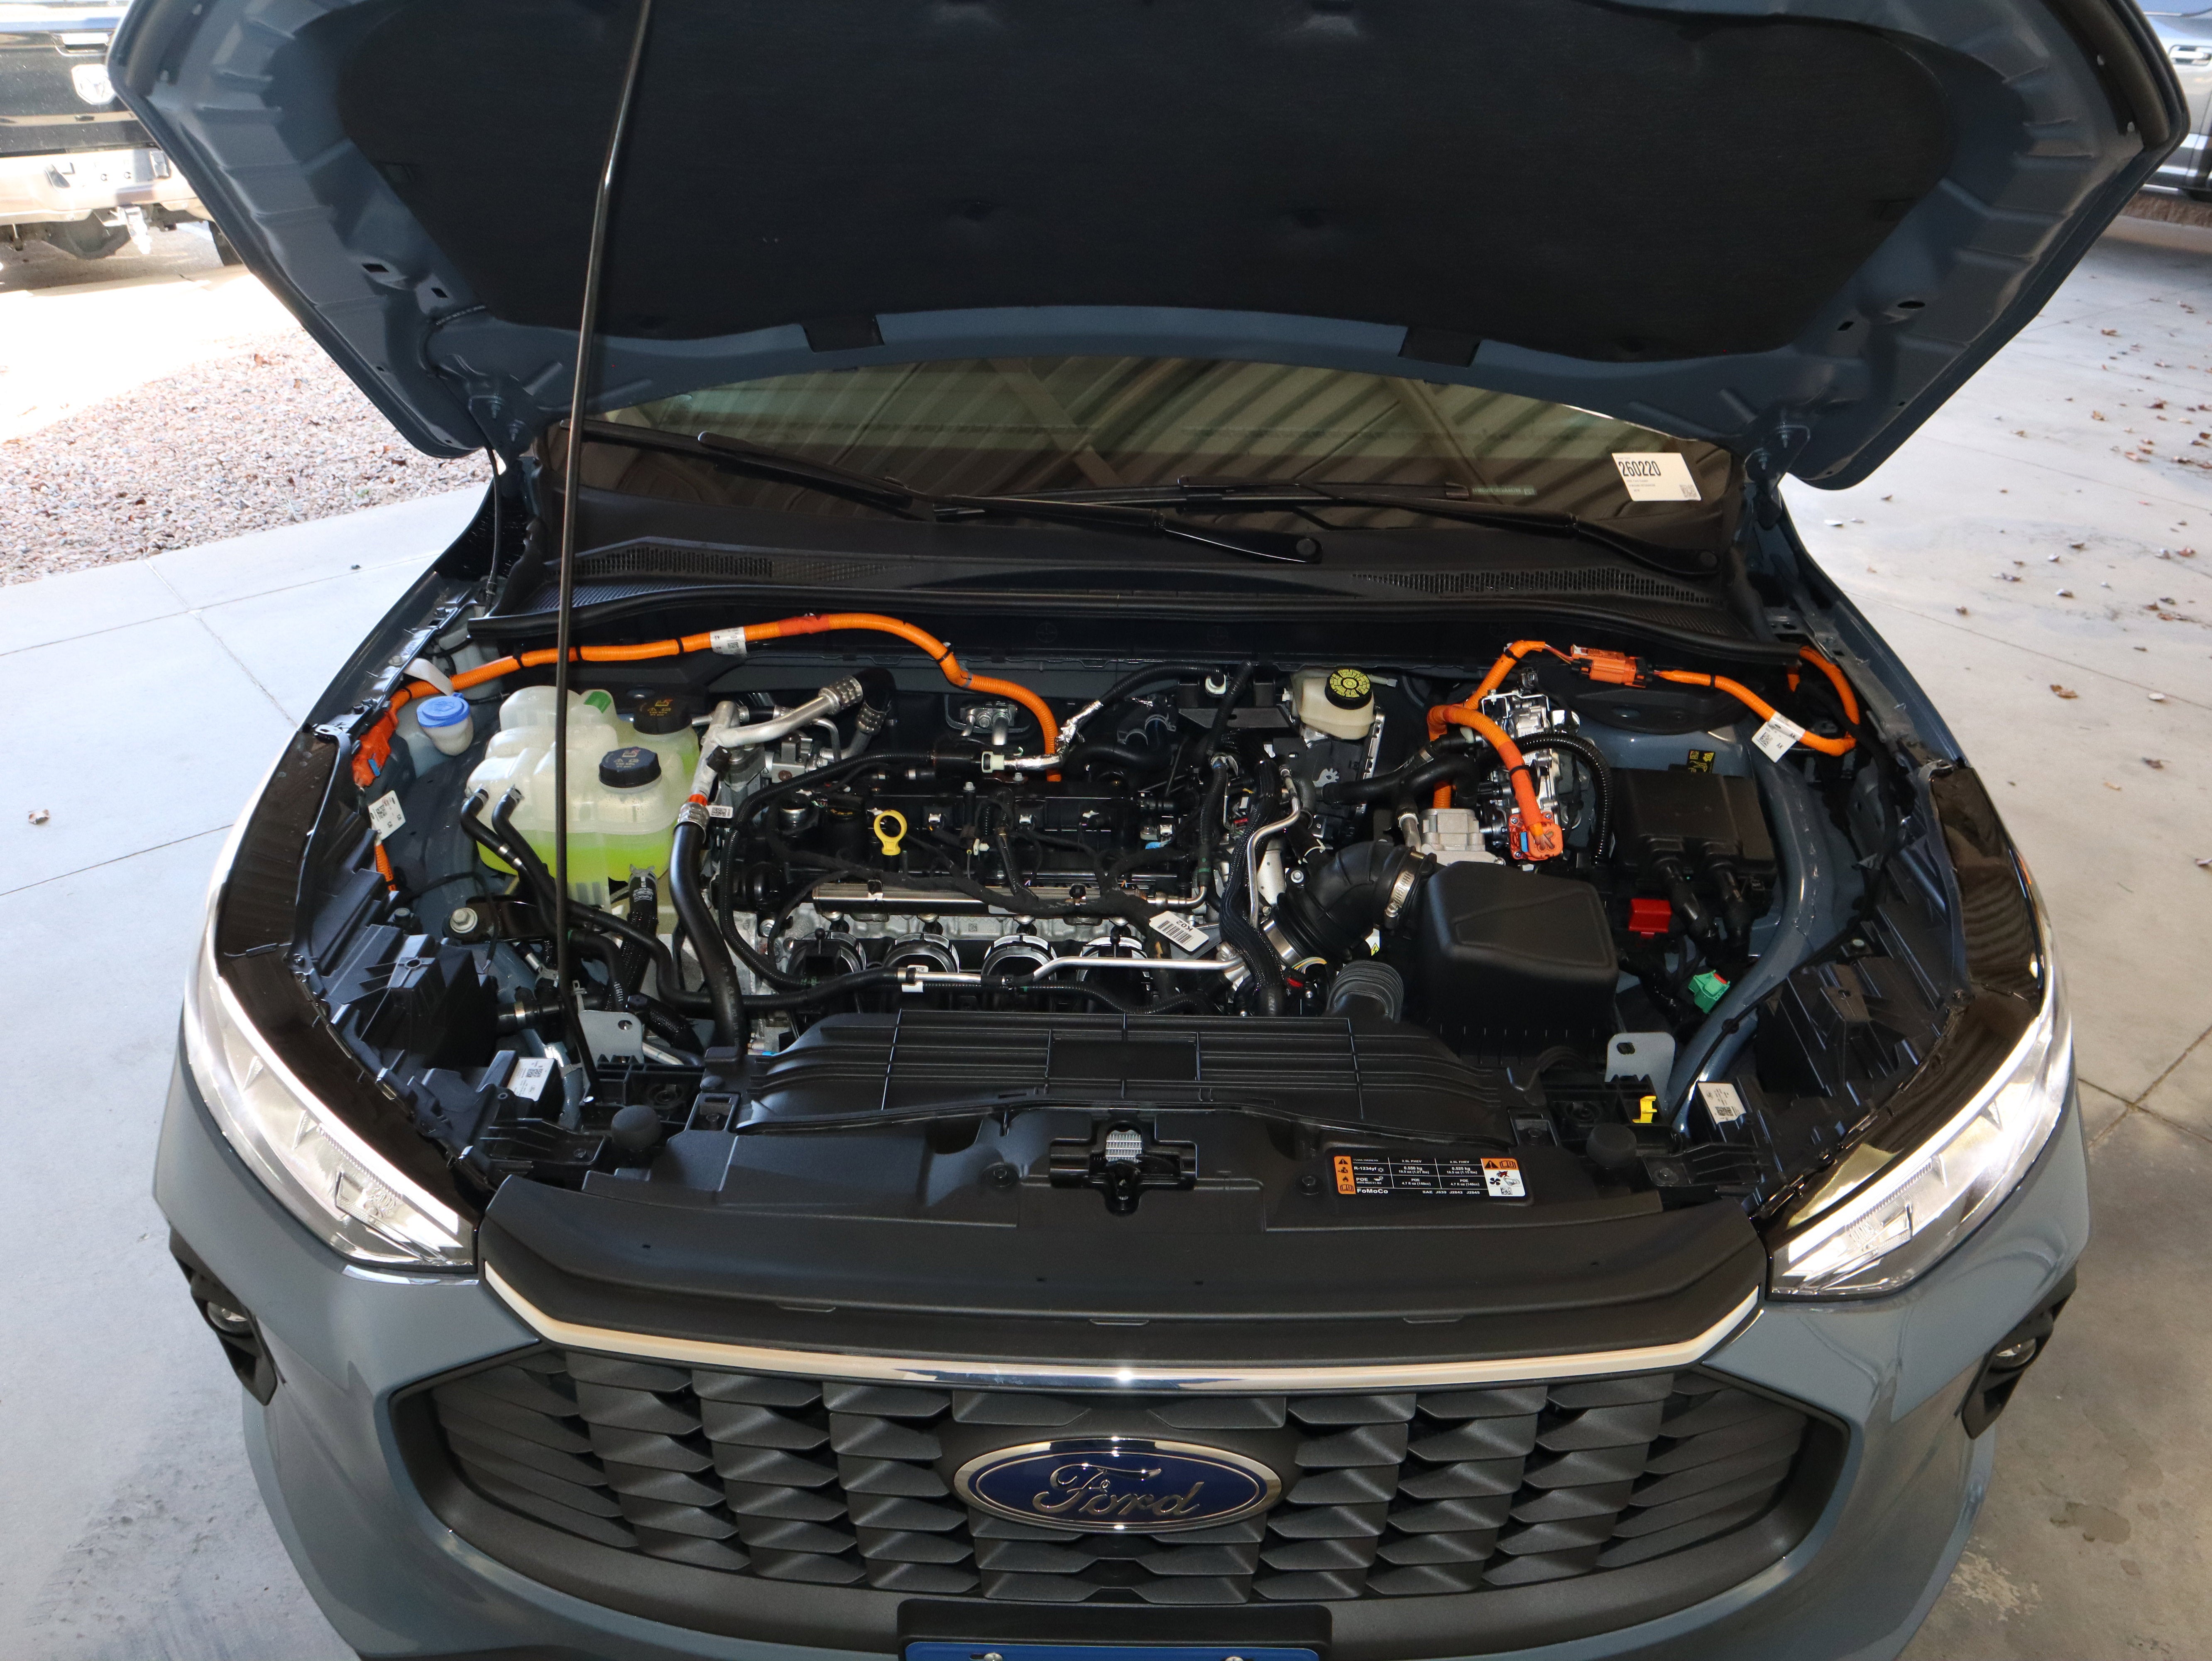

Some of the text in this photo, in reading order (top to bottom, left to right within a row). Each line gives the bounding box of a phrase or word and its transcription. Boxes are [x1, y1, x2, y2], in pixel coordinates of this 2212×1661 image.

[1619, 461, 1661, 476] 260220
[1177, 920, 1193, 931] K02
[1032, 1463, 1205, 1516] Ford
